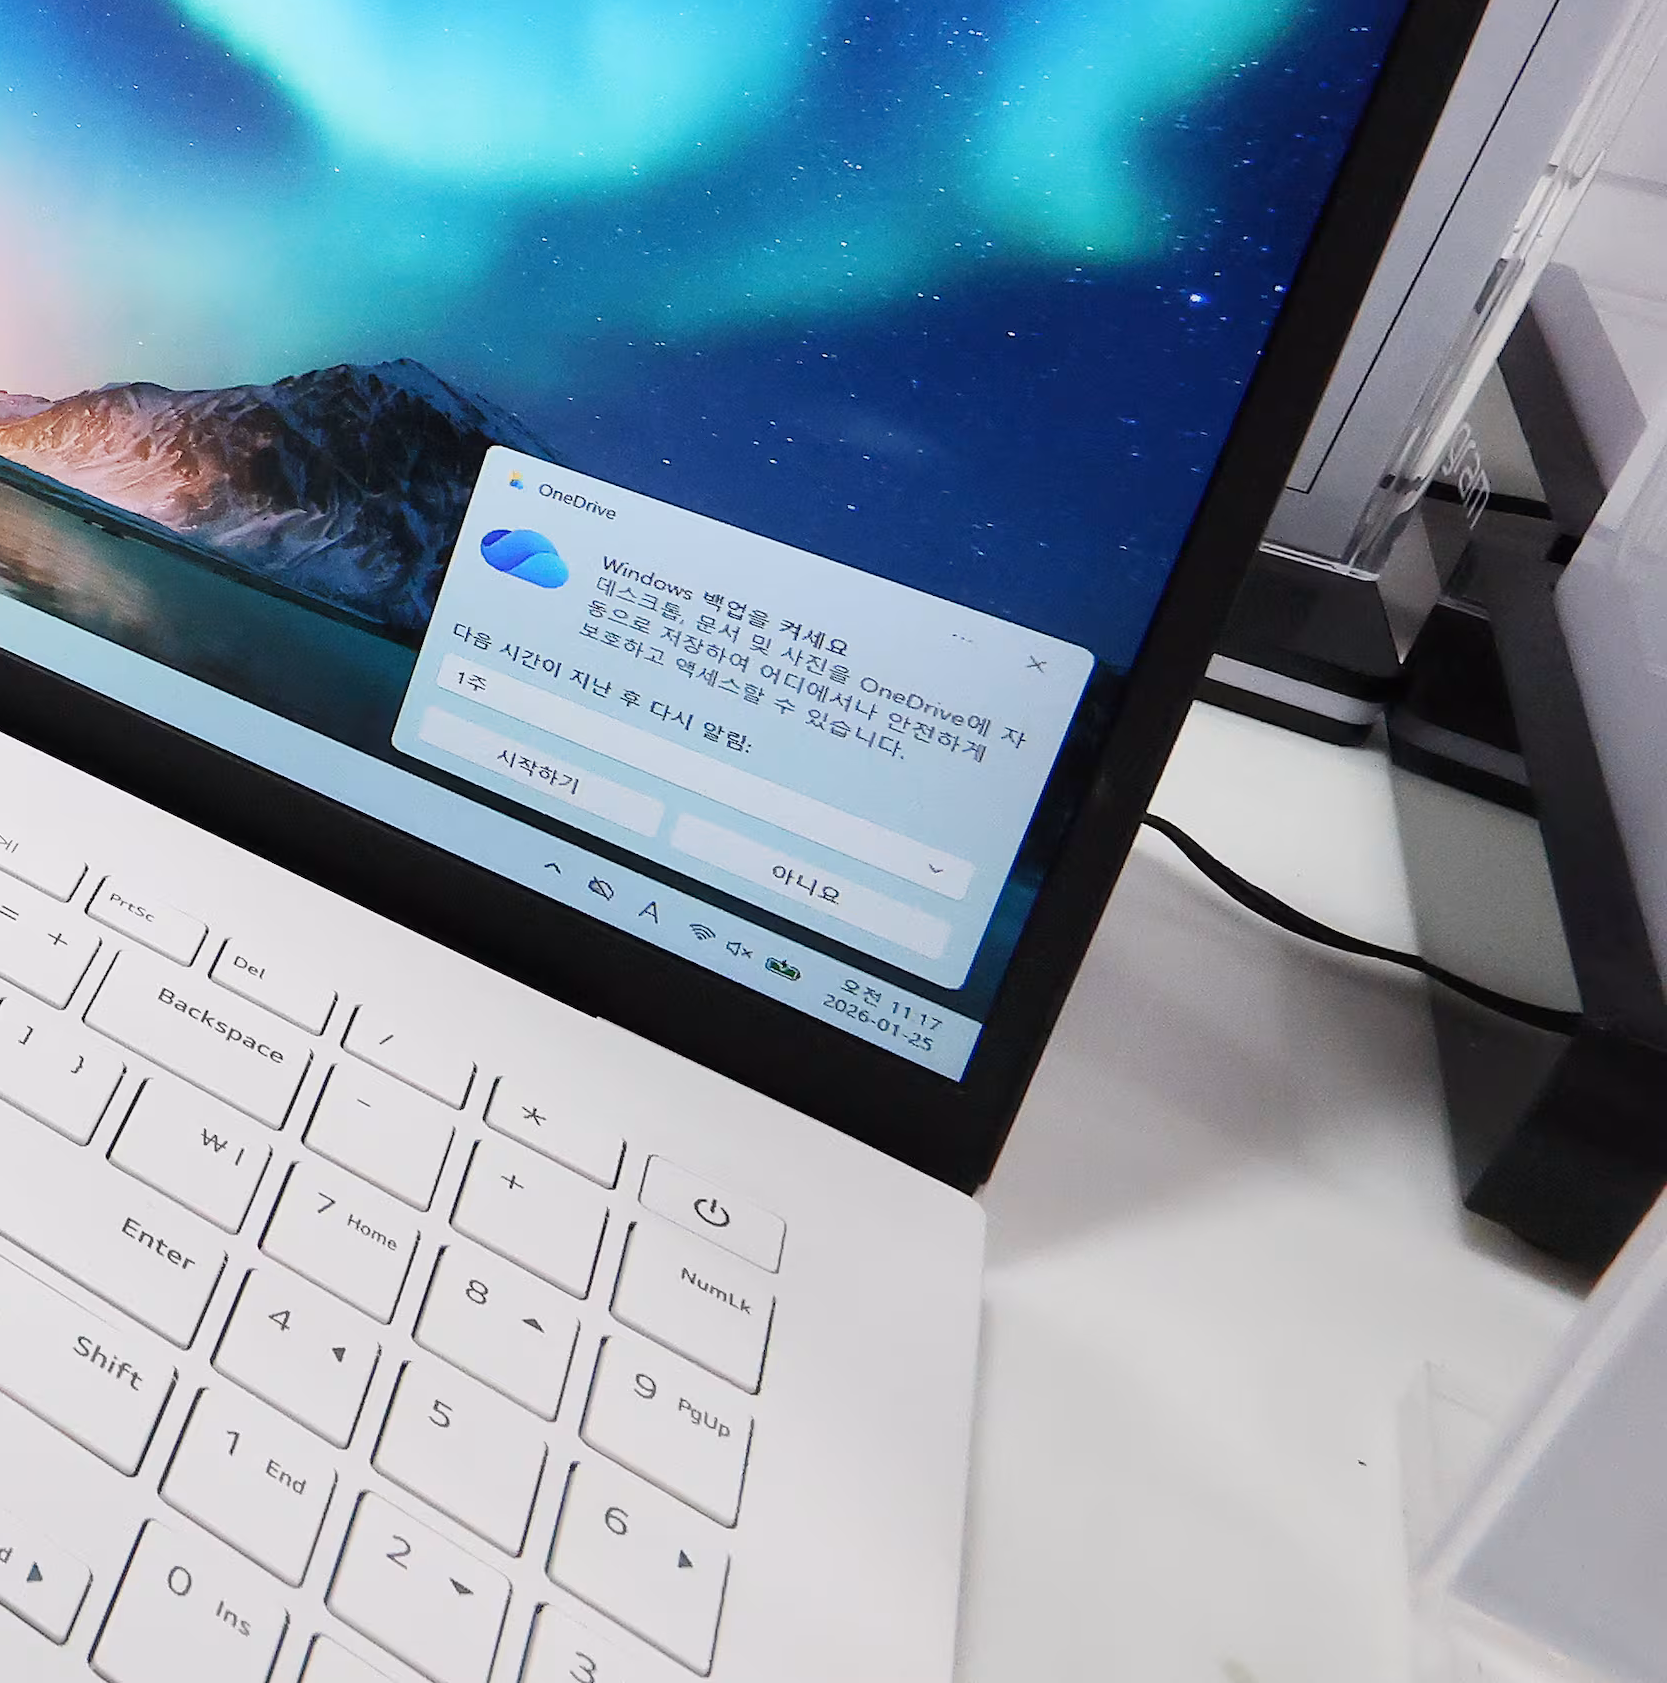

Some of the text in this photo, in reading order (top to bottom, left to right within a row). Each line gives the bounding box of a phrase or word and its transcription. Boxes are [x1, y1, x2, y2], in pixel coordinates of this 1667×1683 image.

[538, 482, 617, 521] OneDrive
[601, 555, 850, 658] Windows 백업을 켜세요
[456, 669, 489, 695] 1주
[586, 598, 988, 763] 동으로 저장하여 어디에서나 안전하게
[594, 576, 1028, 751] 데스크톱, 문서 및 사진을 OneDrive에 자
[452, 620, 753, 756] 다음 시간이 지난 후 다시 알림:
[579, 620, 907, 762] 보호하고 액세스할 수 있습니다.
[496, 746, 580, 796] 시작하기
[109, 891, 156, 923] PrtSc
[771, 863, 842, 907] 아니요
[638, 899, 662, 925] A
[233, 955, 266, 980] Del
[839, 975, 883, 1008] 오전
[157, 985, 285, 1065] Backspace
[821, 993, 934, 1053] 2026-01-25
[120, 1216, 197, 1272] Enter
[346, 1214, 399, 1251] Home
[680, 1266, 753, 1314] NumLk
[72, 1335, 143, 1392] Shift
[678, 1398, 732, 1439] PgUp
[265, 1460, 307, 1496] End
[216, 1599, 252, 1637] Ins
